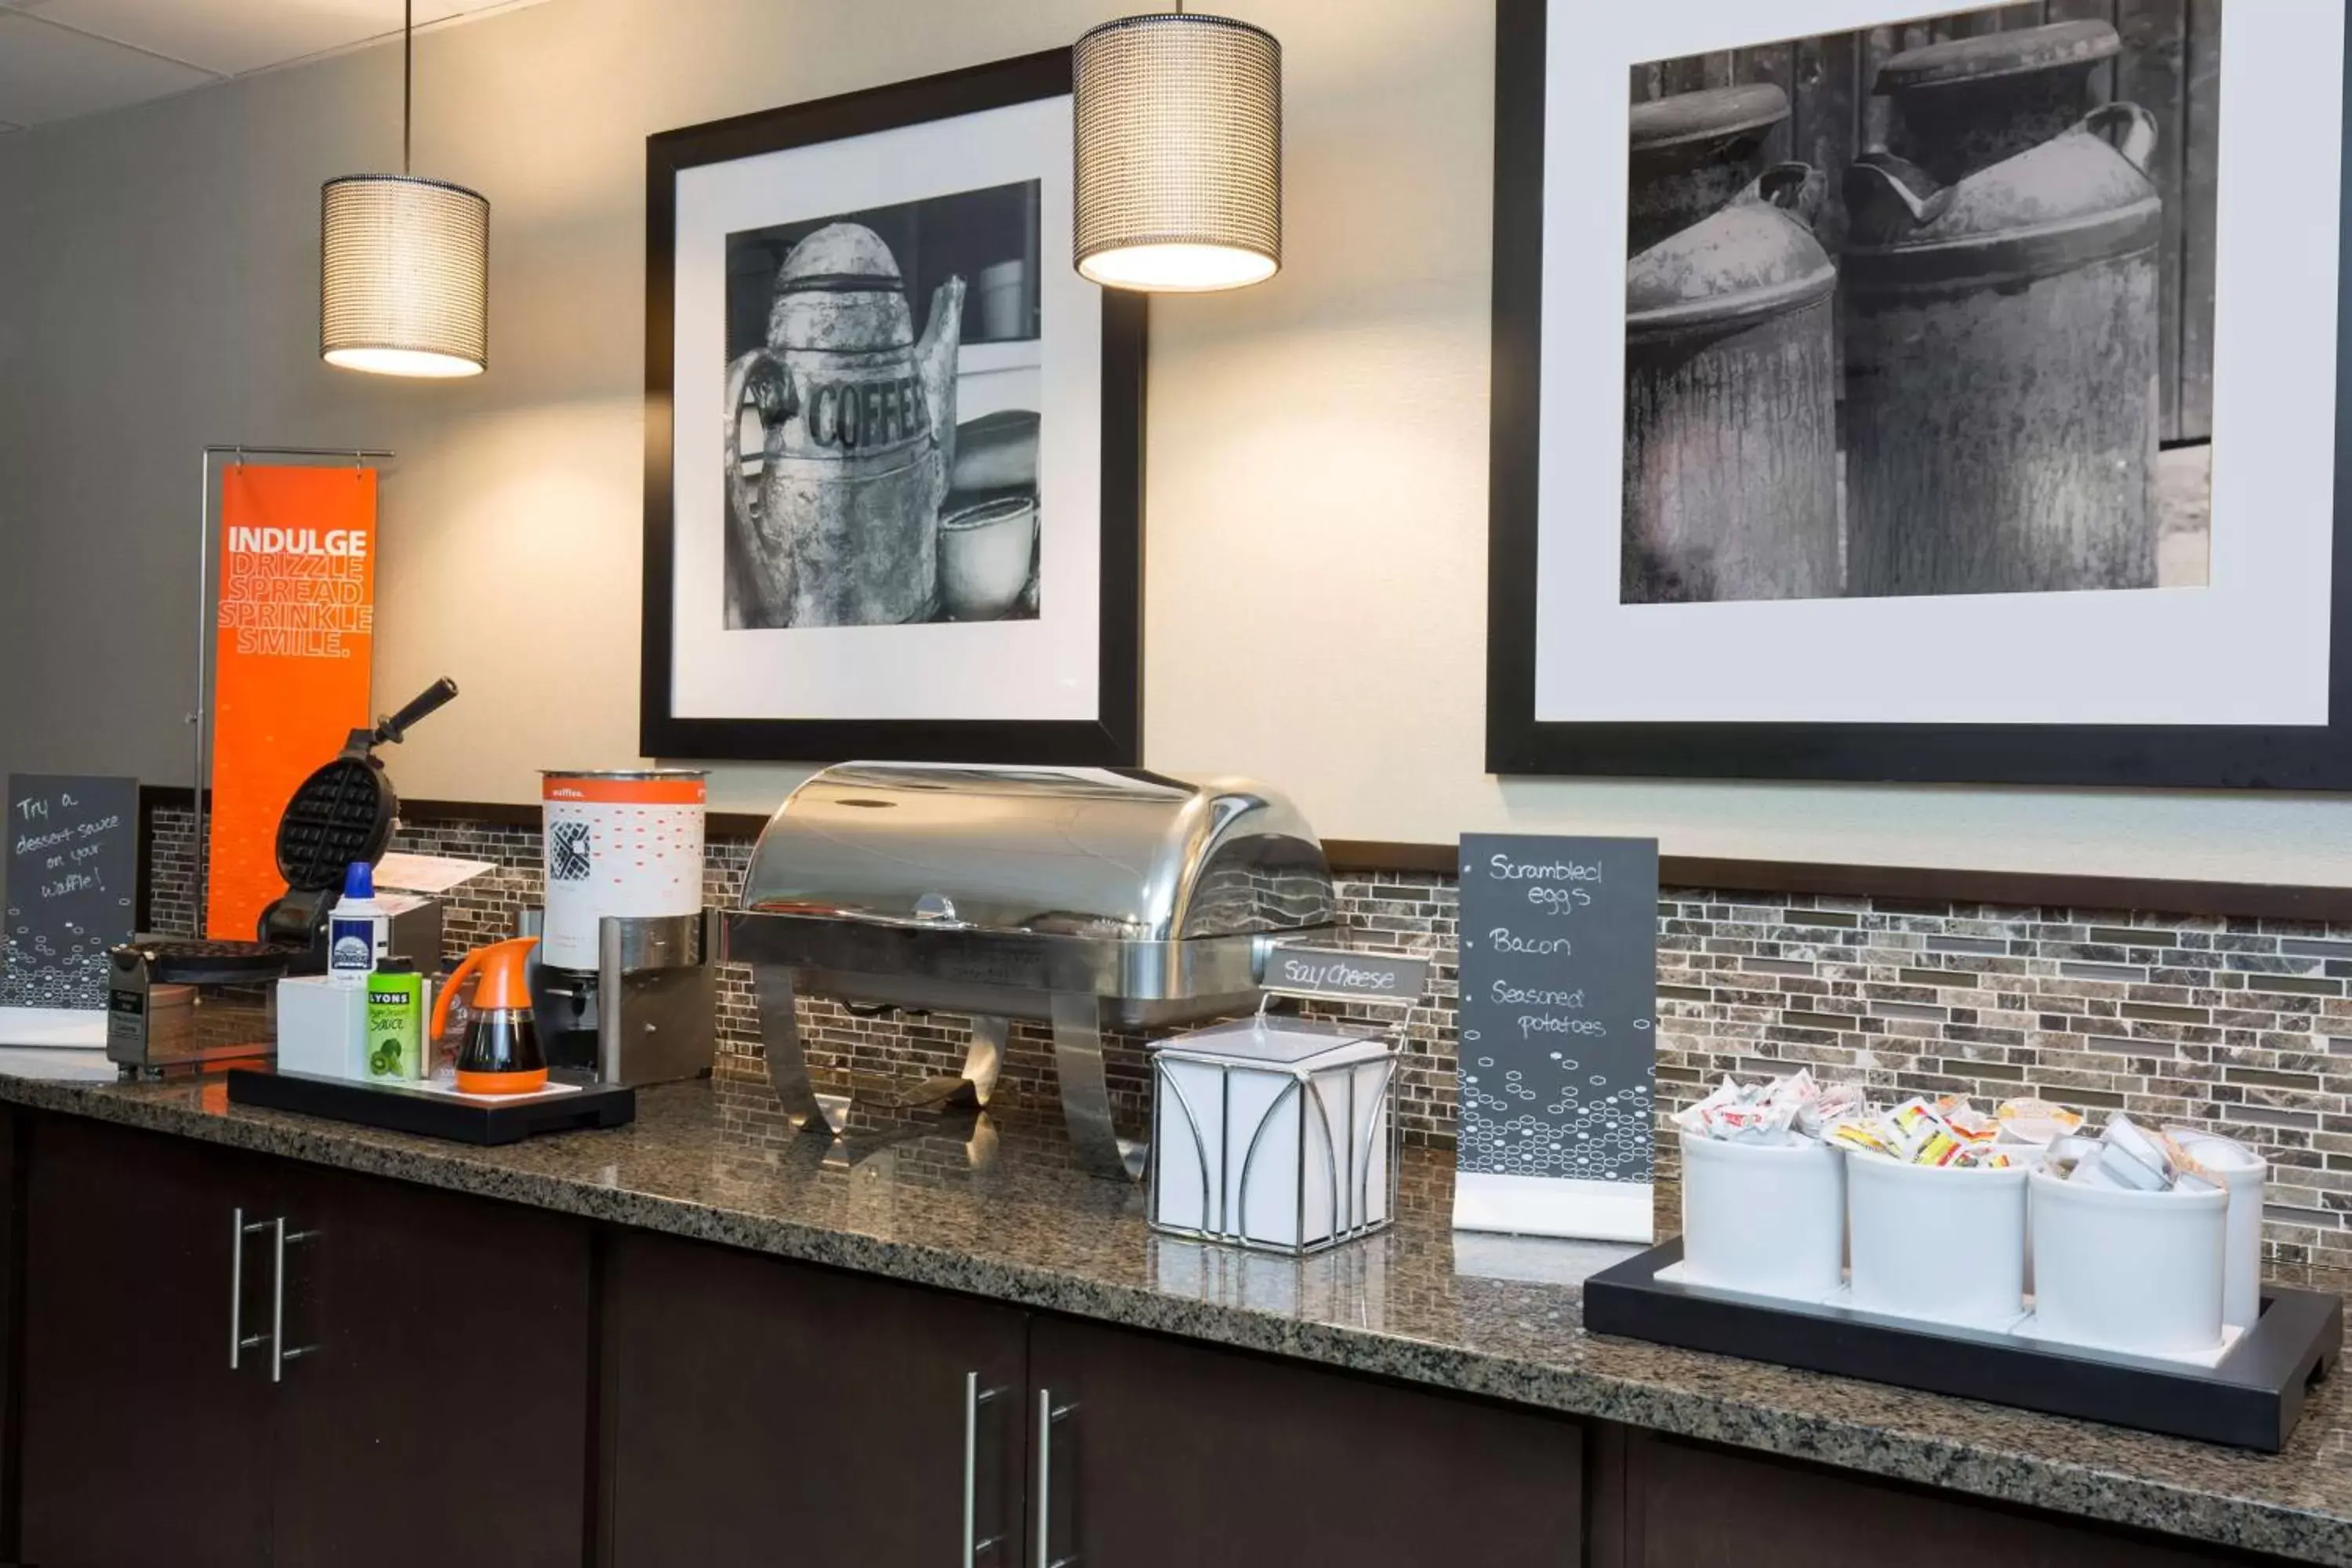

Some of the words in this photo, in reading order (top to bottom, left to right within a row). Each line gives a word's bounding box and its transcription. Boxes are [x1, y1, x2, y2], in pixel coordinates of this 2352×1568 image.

[228, 526, 368, 556] INDULGE
[230, 551, 365, 581] DRIZZLE
[229, 576, 365, 607] SPREAD
[217, 601, 373, 633] SPRINKLE
[238, 628, 350, 659] SMILE.
[16, 797, 48, 820] Try
[61, 793, 78, 807] a
[16, 831, 73, 855] dessert
[1490, 854, 1602, 884] Scrambled
[1529, 887, 1591, 915] eggs
[1490, 928, 1571, 956] Bacon
[1284, 960, 1326, 990] Say
[370, 993, 408, 1003] LYONS
[1491, 980, 1585, 1008] Seasoned
[1519, 1013, 1606, 1040] potatoes
